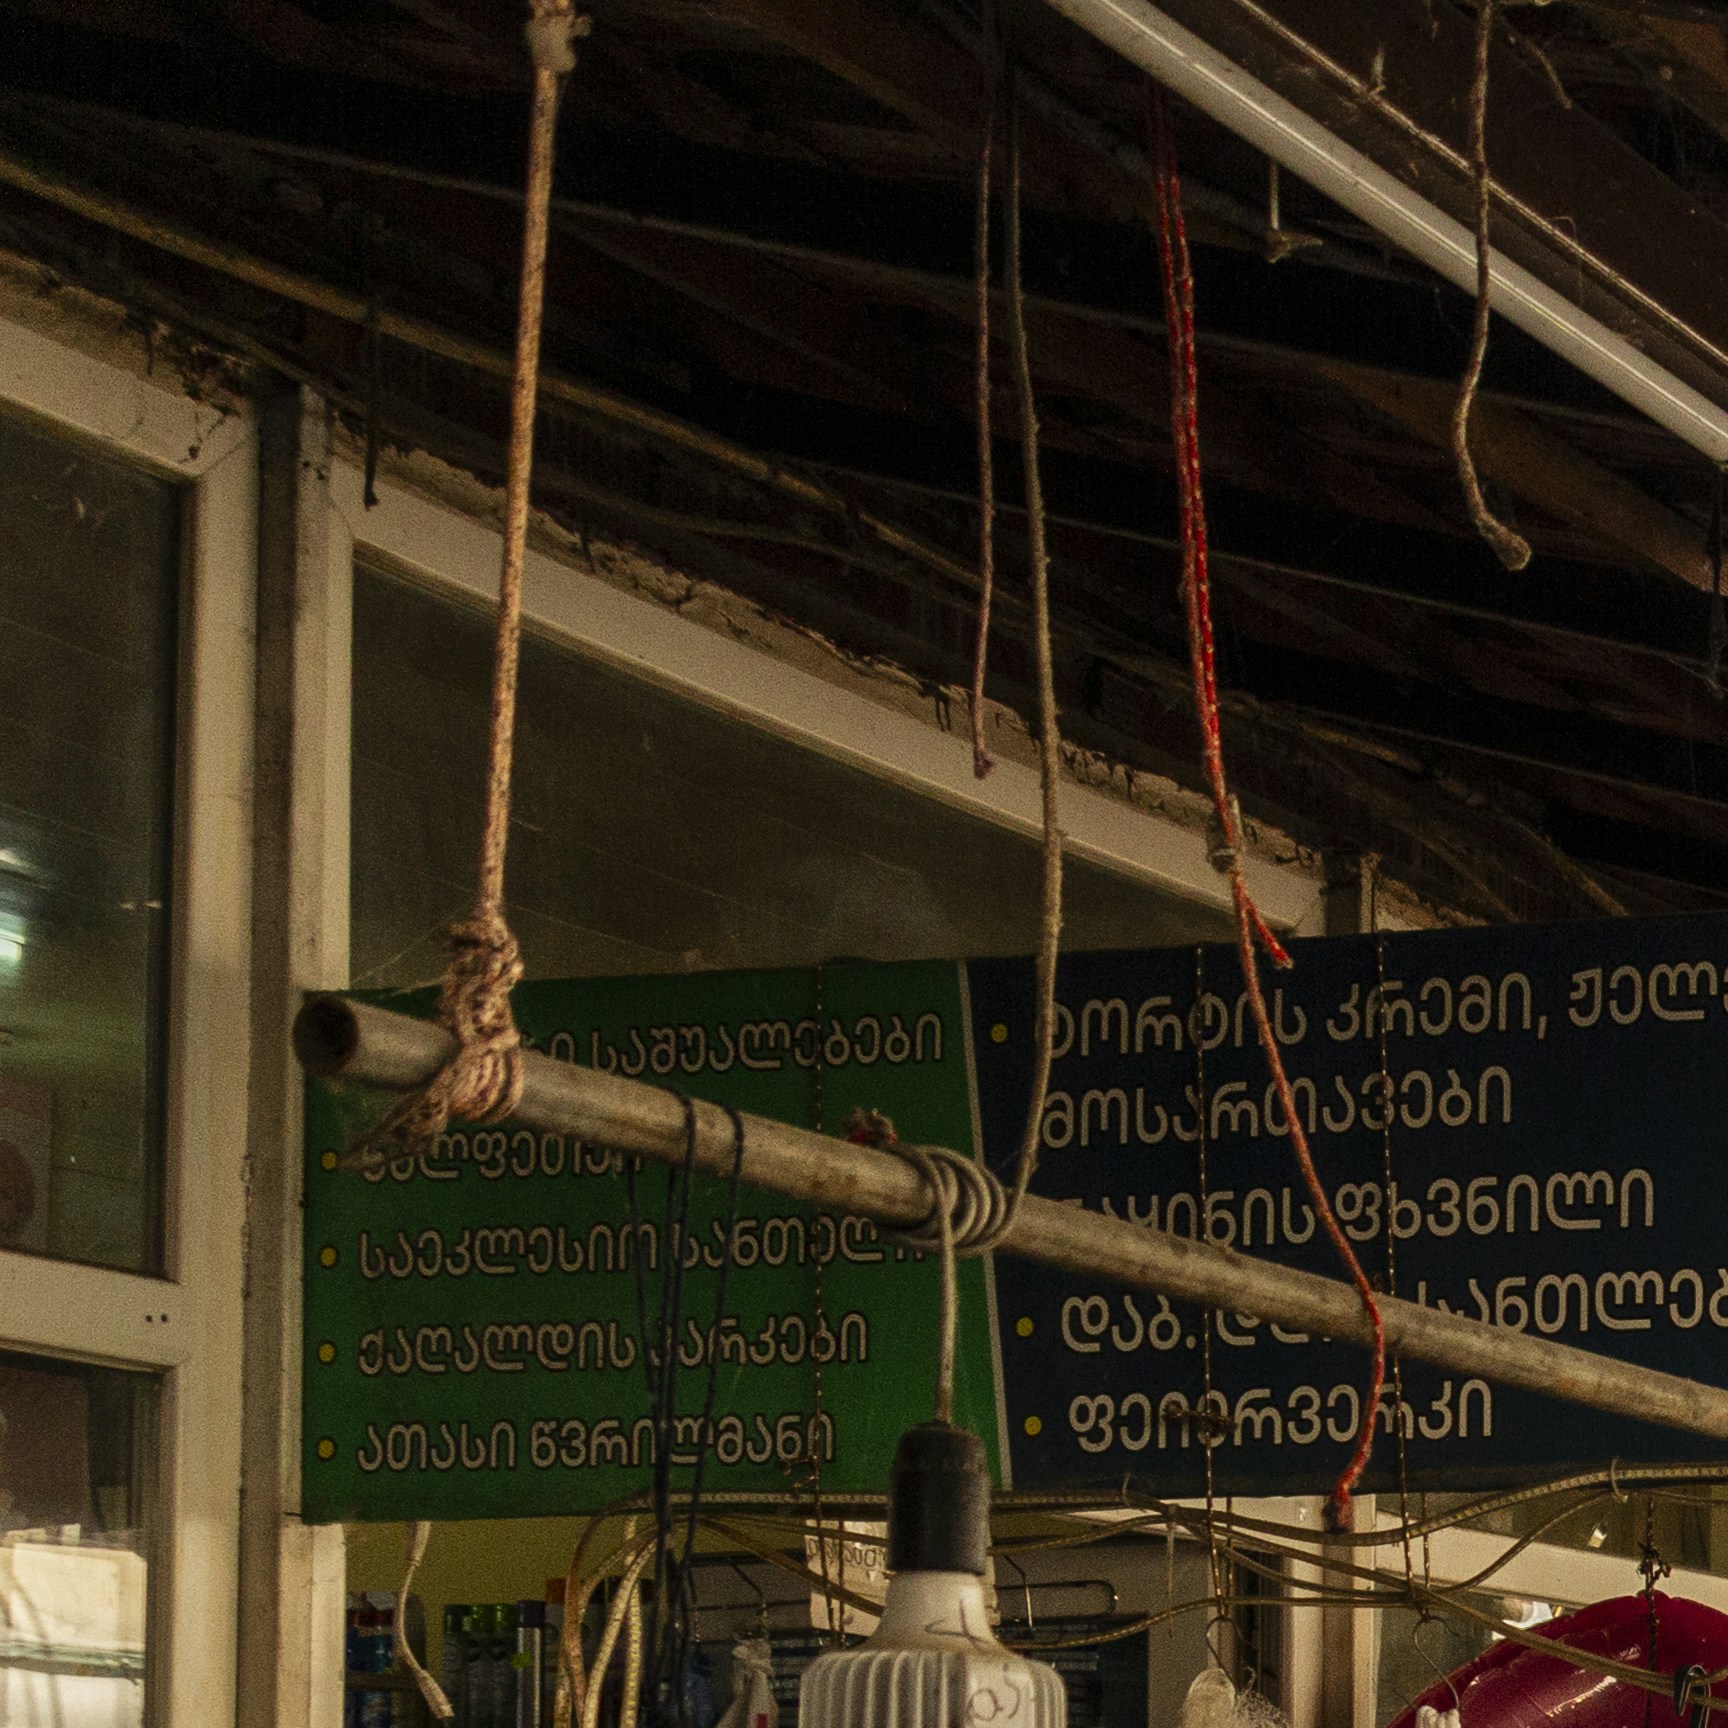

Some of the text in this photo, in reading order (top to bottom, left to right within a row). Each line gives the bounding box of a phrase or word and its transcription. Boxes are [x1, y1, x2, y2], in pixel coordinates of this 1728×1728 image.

[1327, 970, 1548, 1041] კრემი,
[592, 1014, 942, 1075] საშუალებები
[1043, 1066, 1512, 1148] მოსართავები
[1335, 1169, 1655, 1244] ფხვნილი
[359, 1215, 922, 1279] საეკლესიო სანთელ
[357, 1312, 868, 1375] ქაღალდის არკები
[357, 1413, 835, 1471] ათასი წვრილმანი
